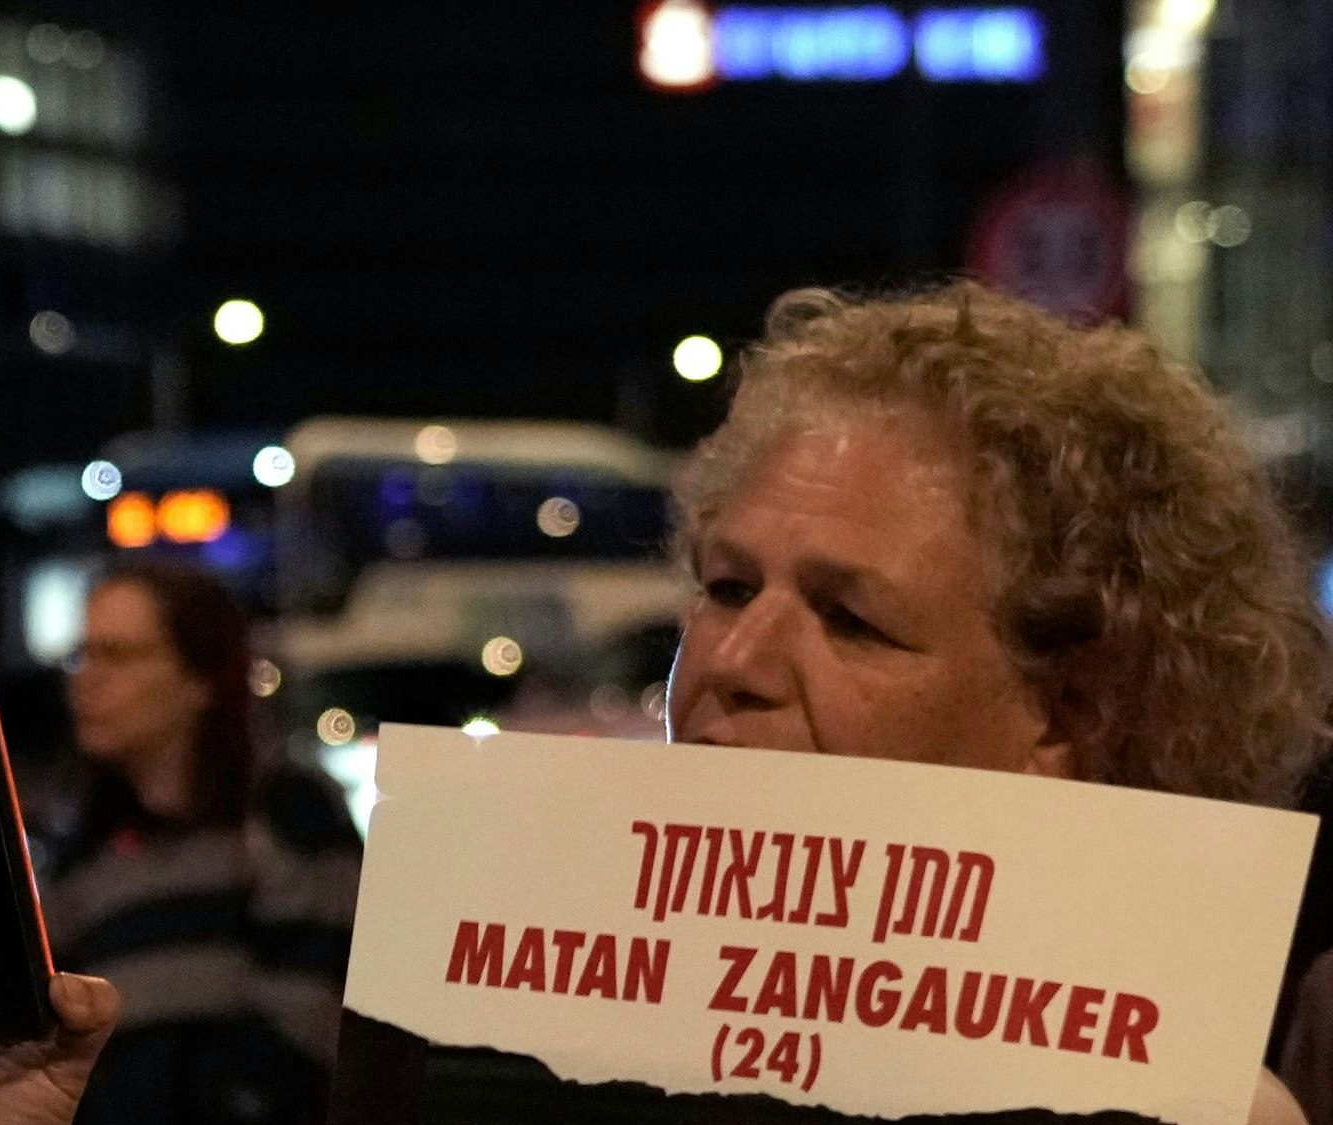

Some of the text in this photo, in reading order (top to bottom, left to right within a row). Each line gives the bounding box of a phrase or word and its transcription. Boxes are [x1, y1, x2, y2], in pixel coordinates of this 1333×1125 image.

[631, 820, 995, 944] מתן צנגאוקר
[446, 920, 1161, 1064] MATAN ZANGAUKER
[711, 1023, 823, 1093] (24)
